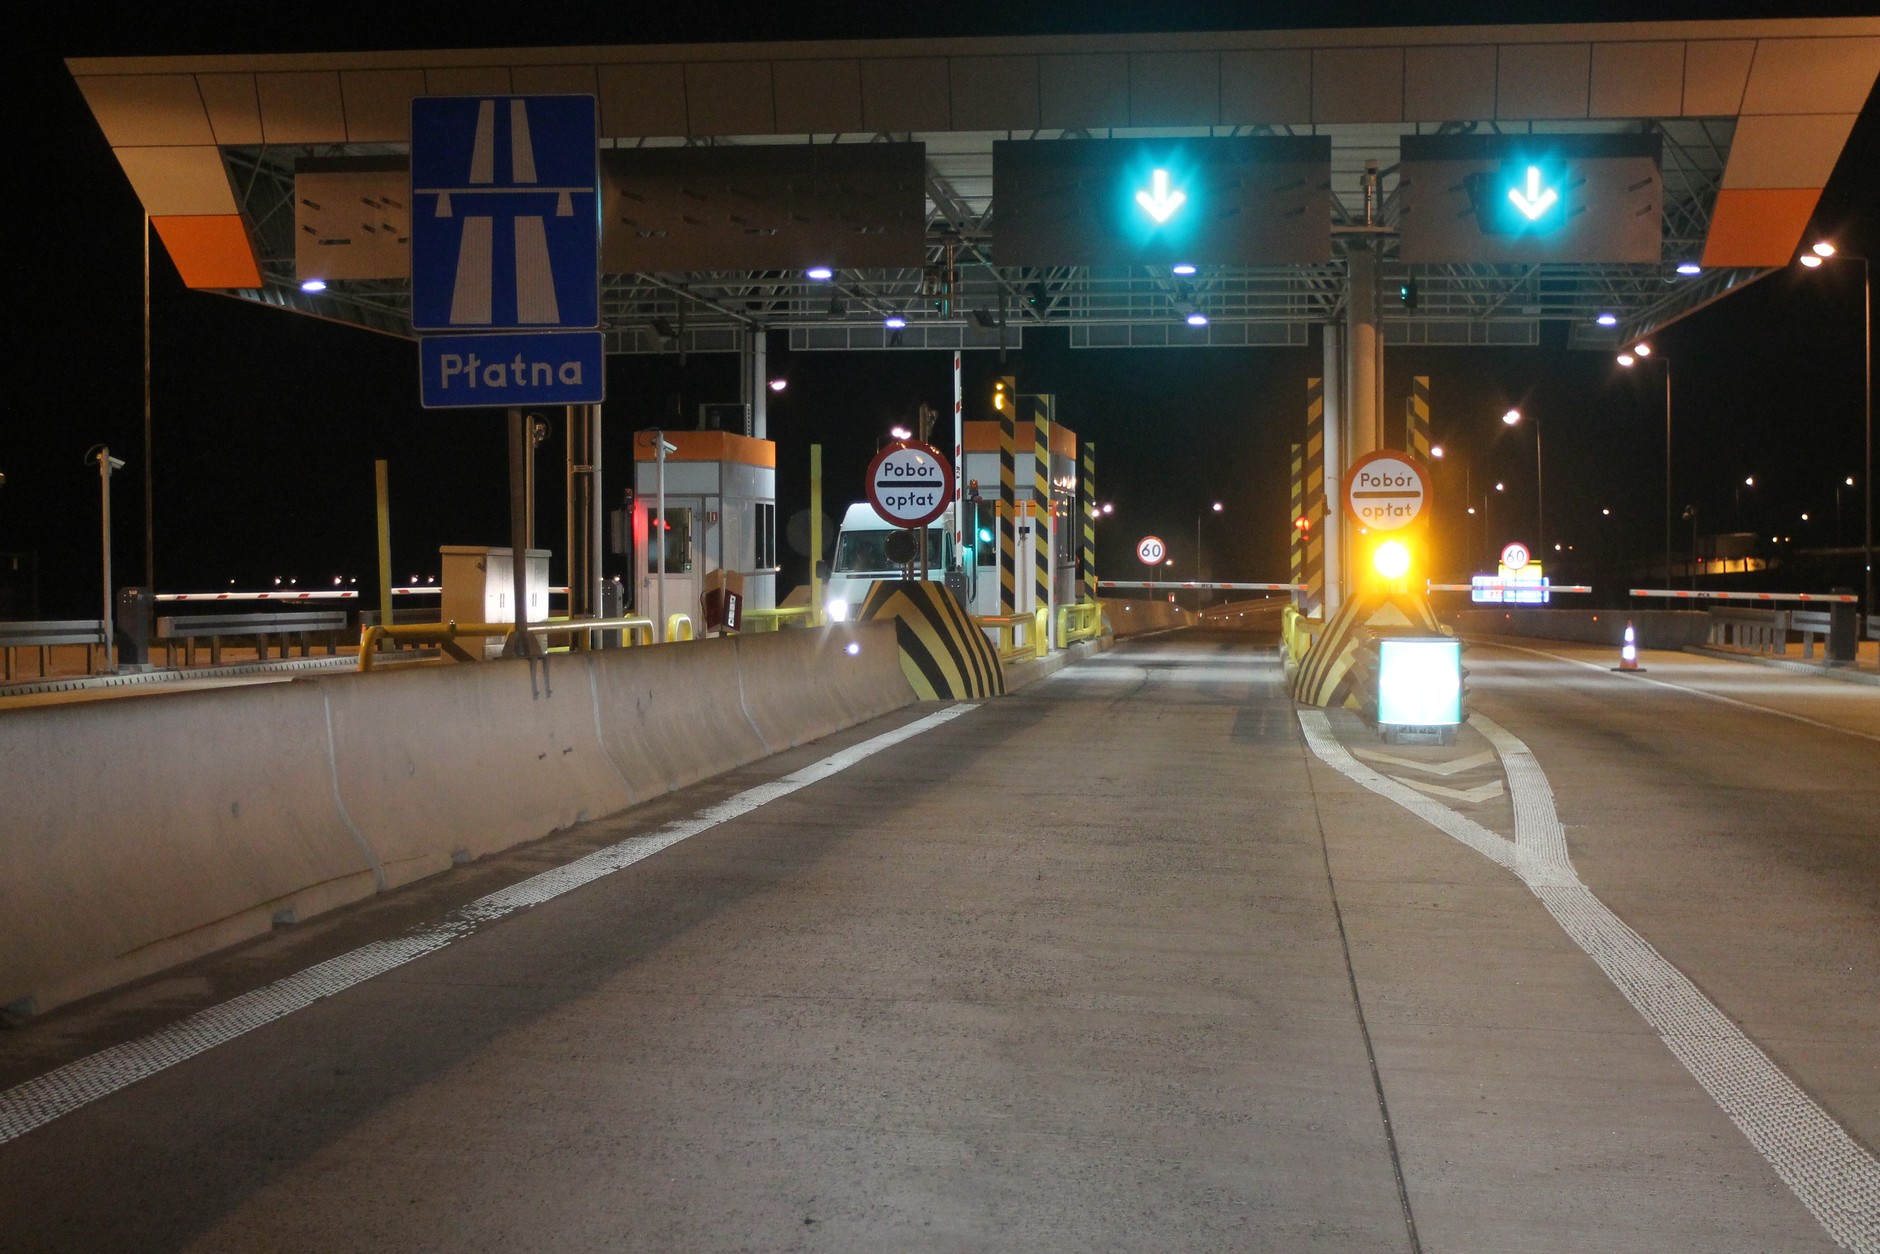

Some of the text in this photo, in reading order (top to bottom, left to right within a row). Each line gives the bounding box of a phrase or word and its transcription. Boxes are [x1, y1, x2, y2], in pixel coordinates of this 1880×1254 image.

[441, 353, 582, 388] Płatna
[884, 462, 934, 476] Pobór
[1360, 472, 1413, 487] Pobór
[885, 492, 934, 510] opłat
[1362, 503, 1412, 520] opłat
[1141, 544, 1161, 557] 60
[1506, 550, 1525, 563] 60
